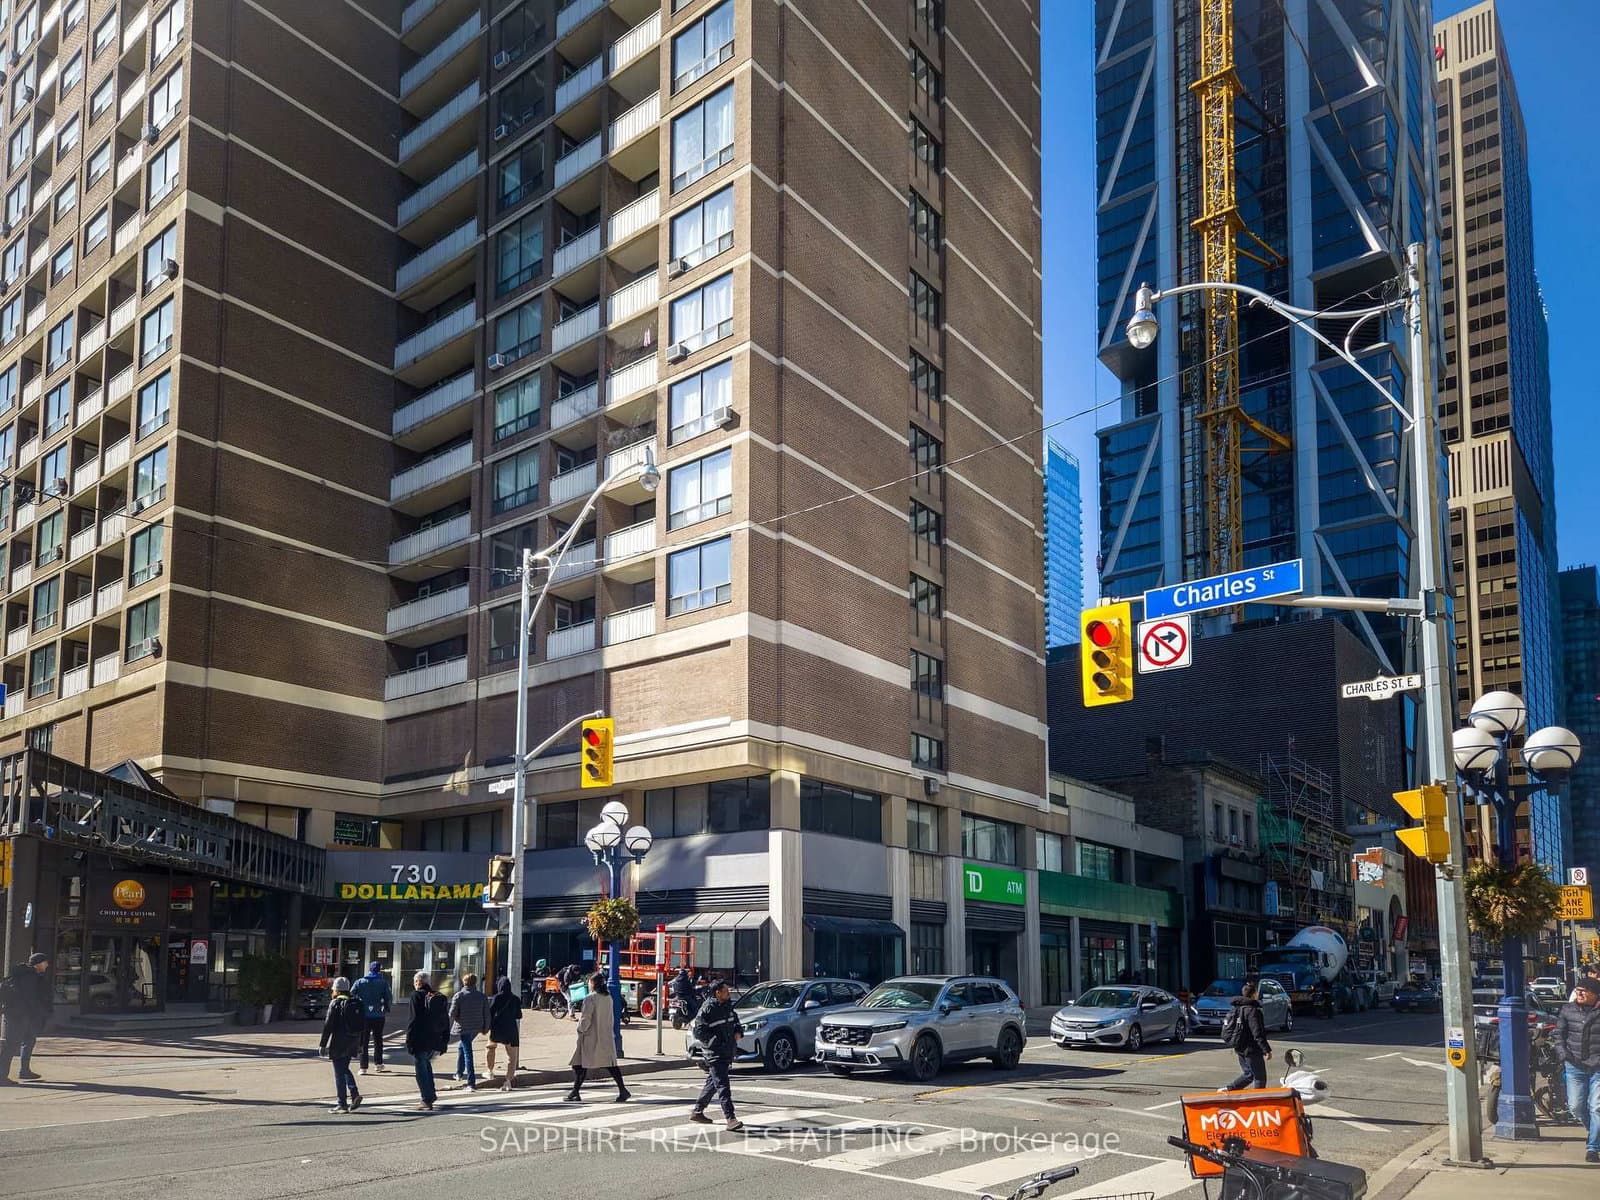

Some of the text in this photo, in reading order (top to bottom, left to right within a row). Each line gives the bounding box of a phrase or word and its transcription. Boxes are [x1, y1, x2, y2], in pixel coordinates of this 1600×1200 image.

[1173, 569, 1275, 607] Charles St
[1345, 680, 1389, 696] CHARLES
[1407, 676, 1417, 687] E.
[390, 864, 437, 884] 730
[966, 870, 983, 893] TD
[116, 887, 143, 899] Pearl
[341, 882, 485, 900] DOLLARAMA
[1006, 881, 1023, 895] ATM
[1200, 1108, 1281, 1131] MOVIN
[1249, 1127, 1280, 1138] Bikes
